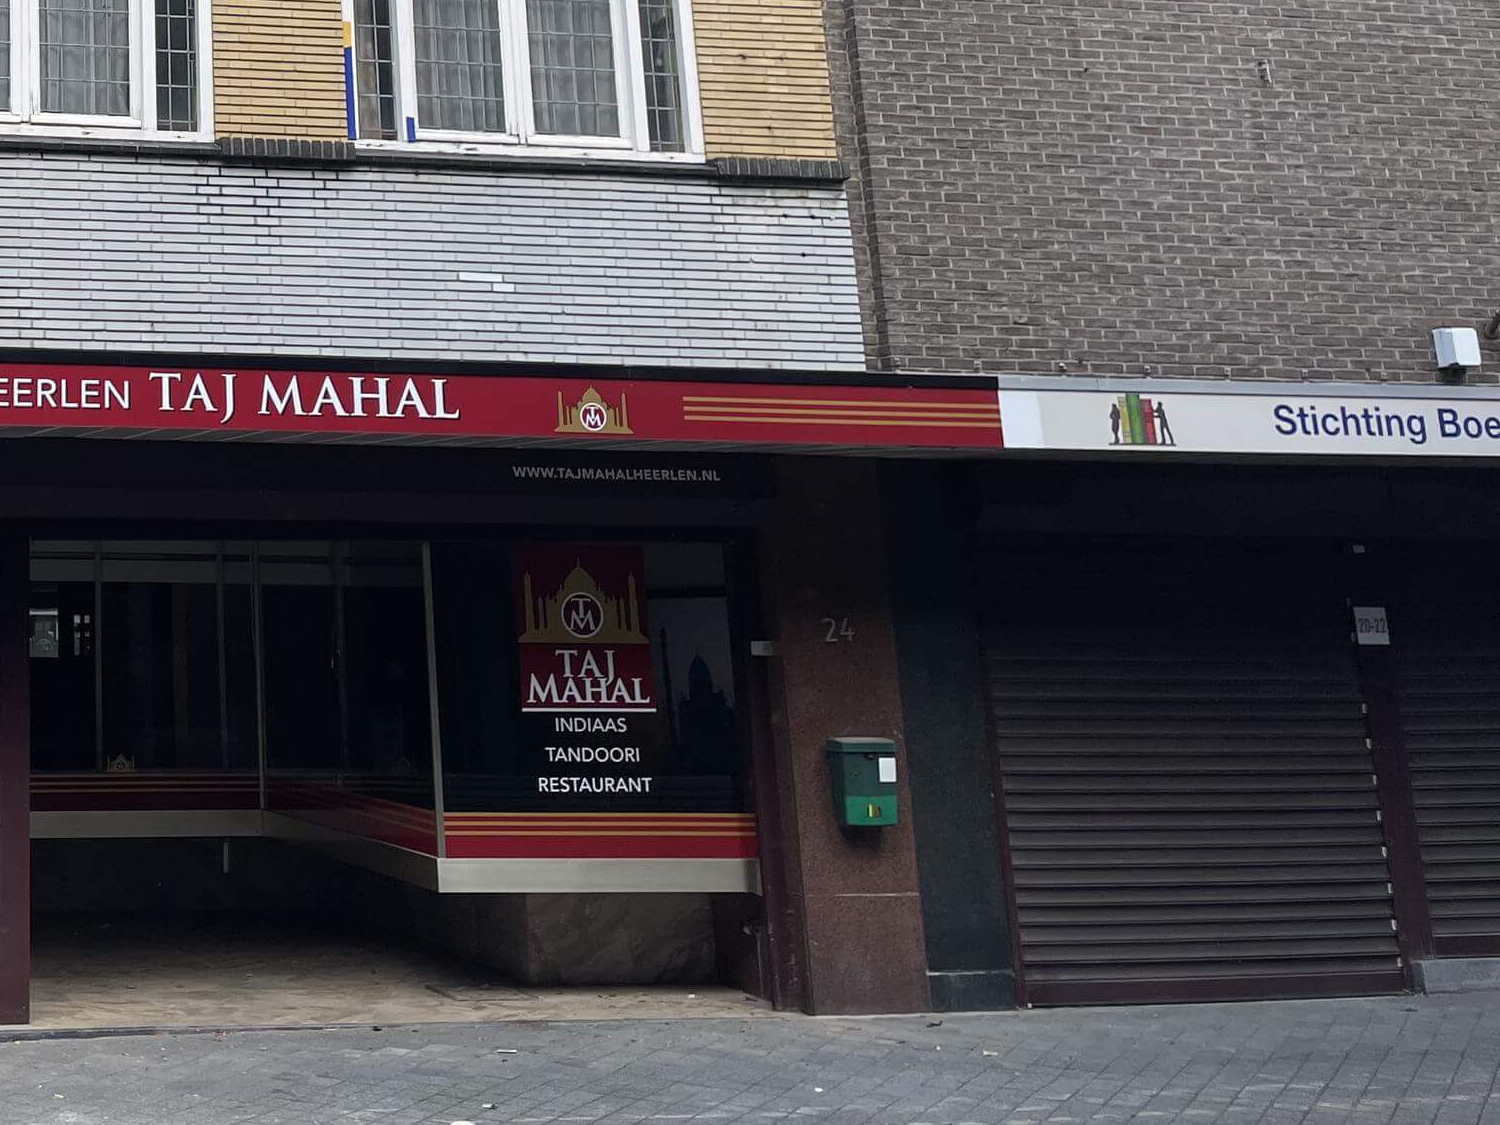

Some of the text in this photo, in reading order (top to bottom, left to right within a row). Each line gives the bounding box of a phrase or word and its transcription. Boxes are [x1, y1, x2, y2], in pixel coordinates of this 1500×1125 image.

[149, 371, 239, 424] TAJ
[257, 374, 461, 420] MAHAL
[1273, 404, 1500, 445] Stichting Boe
[512, 466, 722, 482] WWW.TAJMAHALHEERLEN.NL
[820, 617, 856, 642] 24
[555, 649, 616, 684] TAJ
[526, 673, 651, 703] MAHAL
[554, 717, 627, 733] INDIAAS
[545, 747, 641, 763] TANDOORI
[538, 777, 653, 794] RESTAURANT
